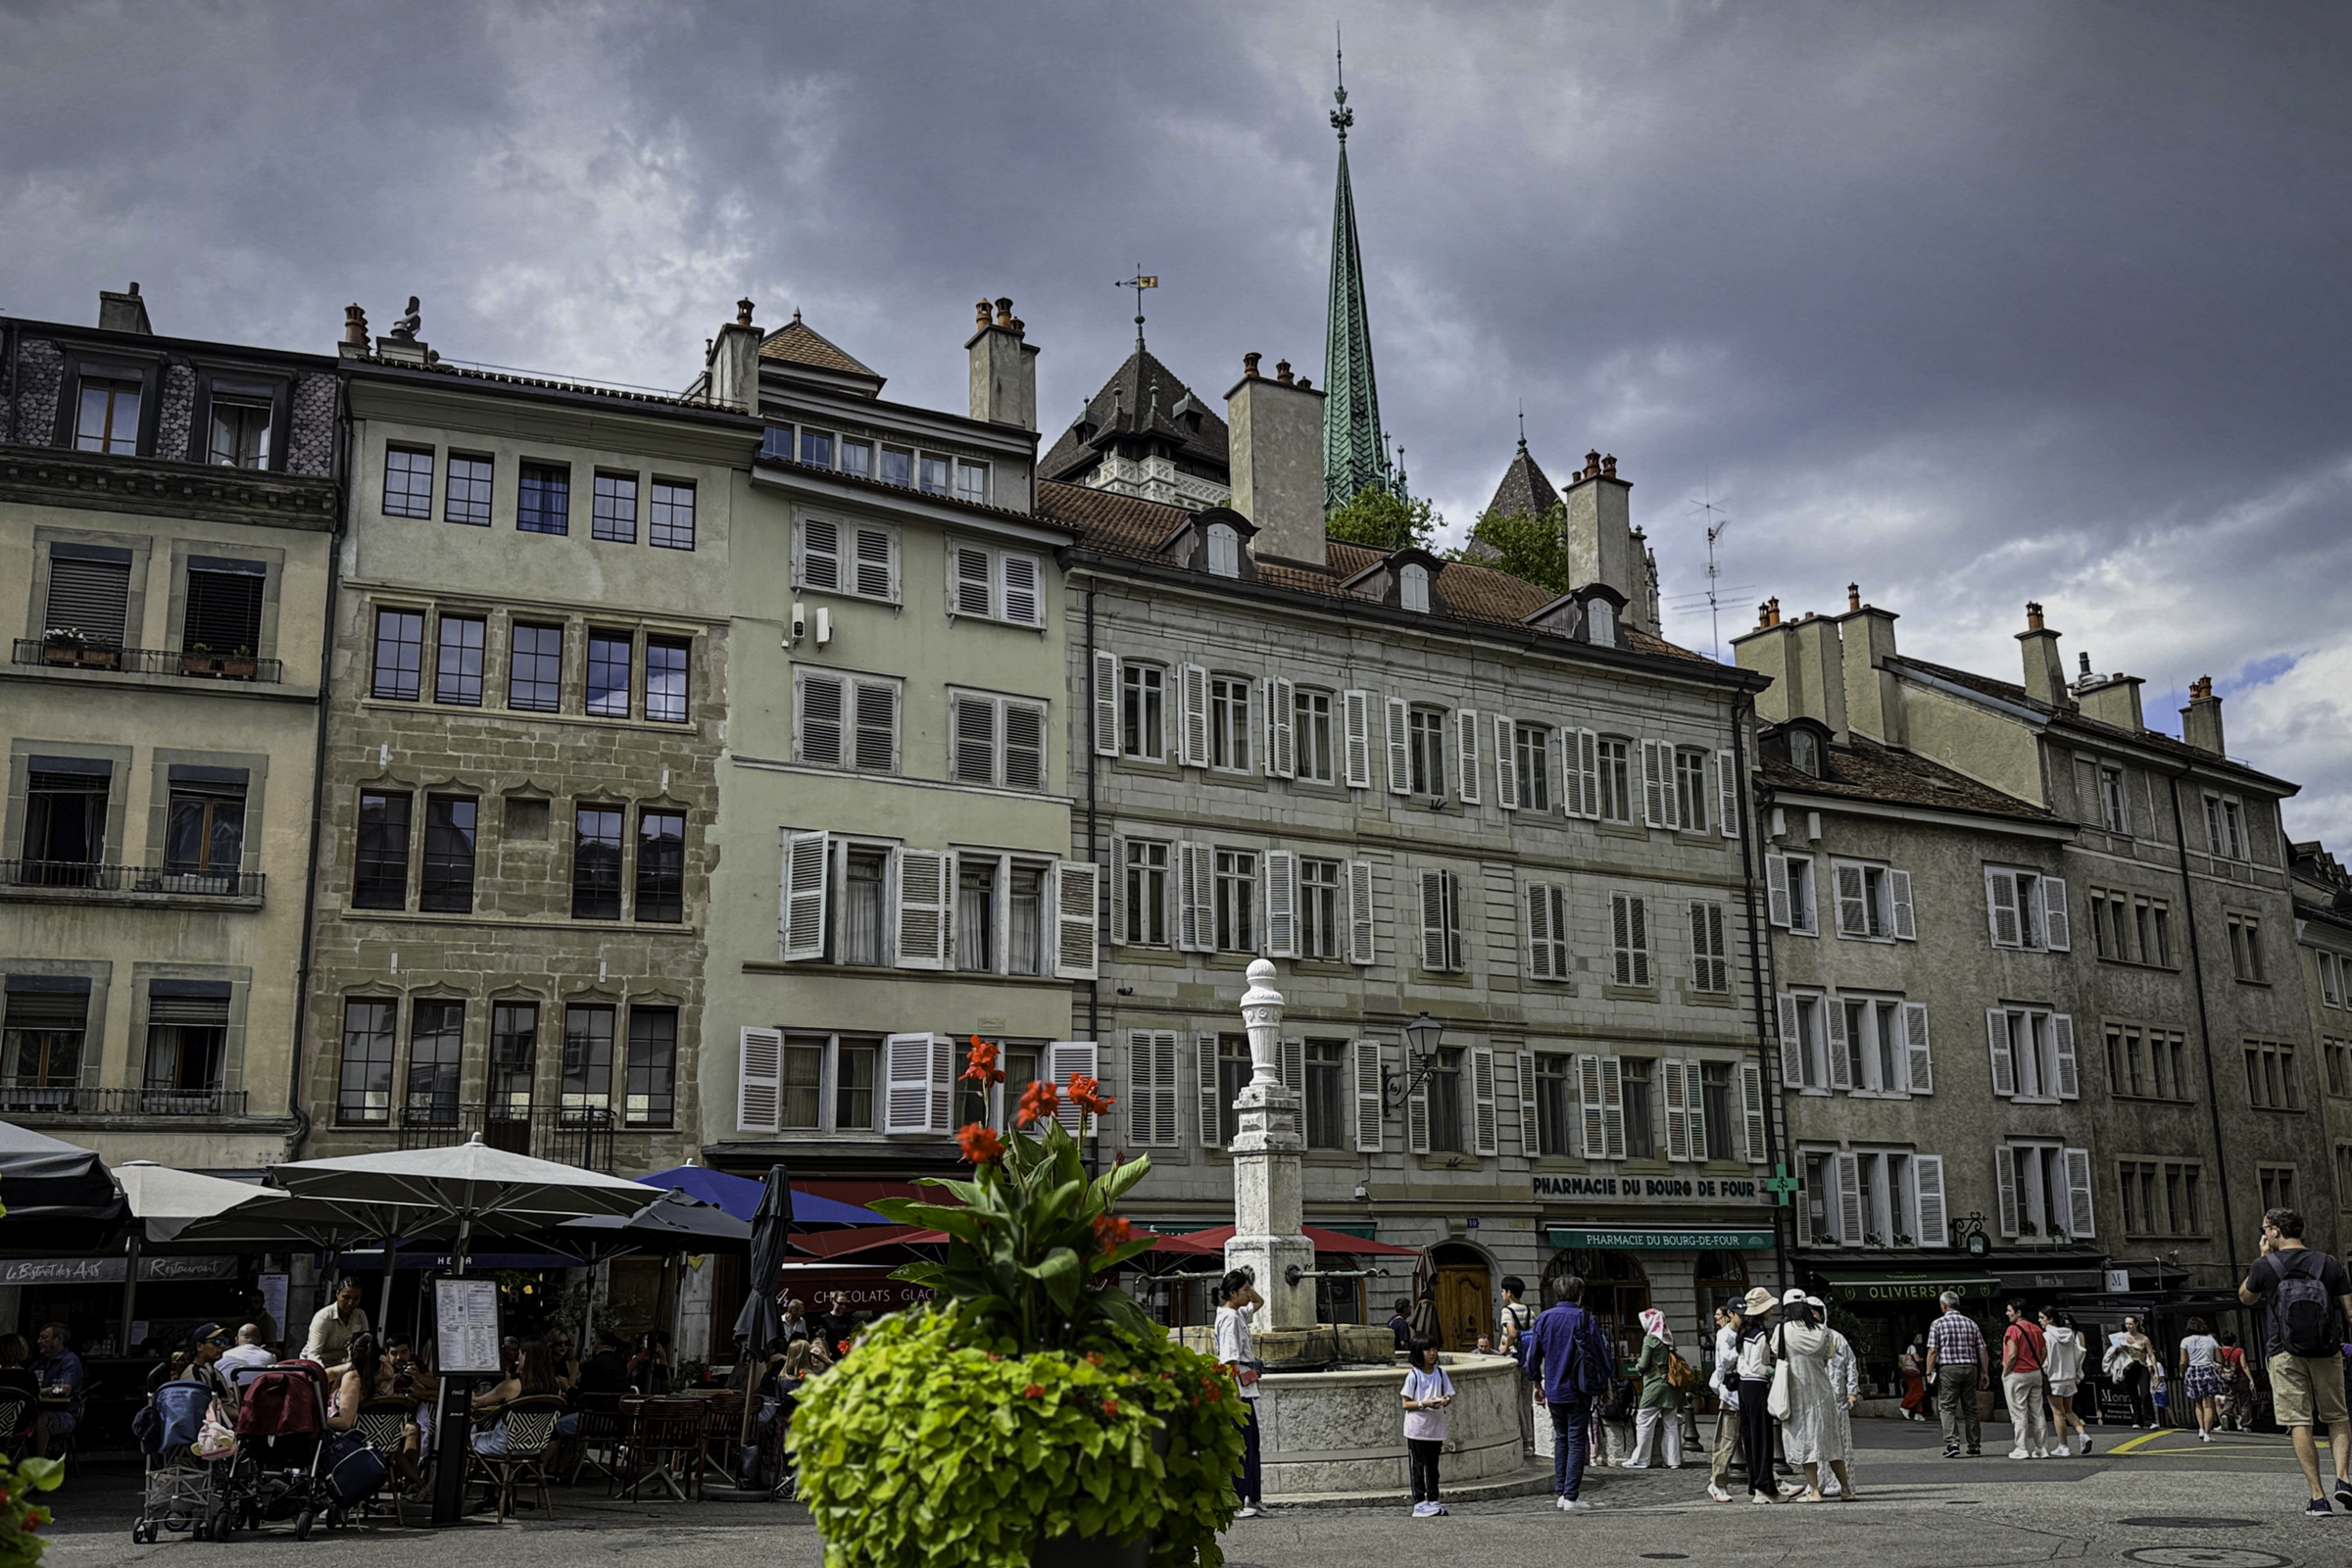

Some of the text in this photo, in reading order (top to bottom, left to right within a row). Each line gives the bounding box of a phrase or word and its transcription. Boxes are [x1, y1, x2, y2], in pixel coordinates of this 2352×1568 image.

[1533, 1177, 1755, 1197] PHARMACIE DU BOURG DE FOUR
[1586, 1235, 1740, 1246] PHARMACIE DU BOURG-DE-FOUR
[437, 1256, 472, 1265] HEA
[6, 1260, 103, 1280] Le Bistrot des Arts
[150, 1258, 223, 1277] Restaurant
[2112, 1274, 2122, 1286] M
[813, 1290, 890, 1303] CHCOLATS
[2101, 1389, 2132, 1402] Monn
